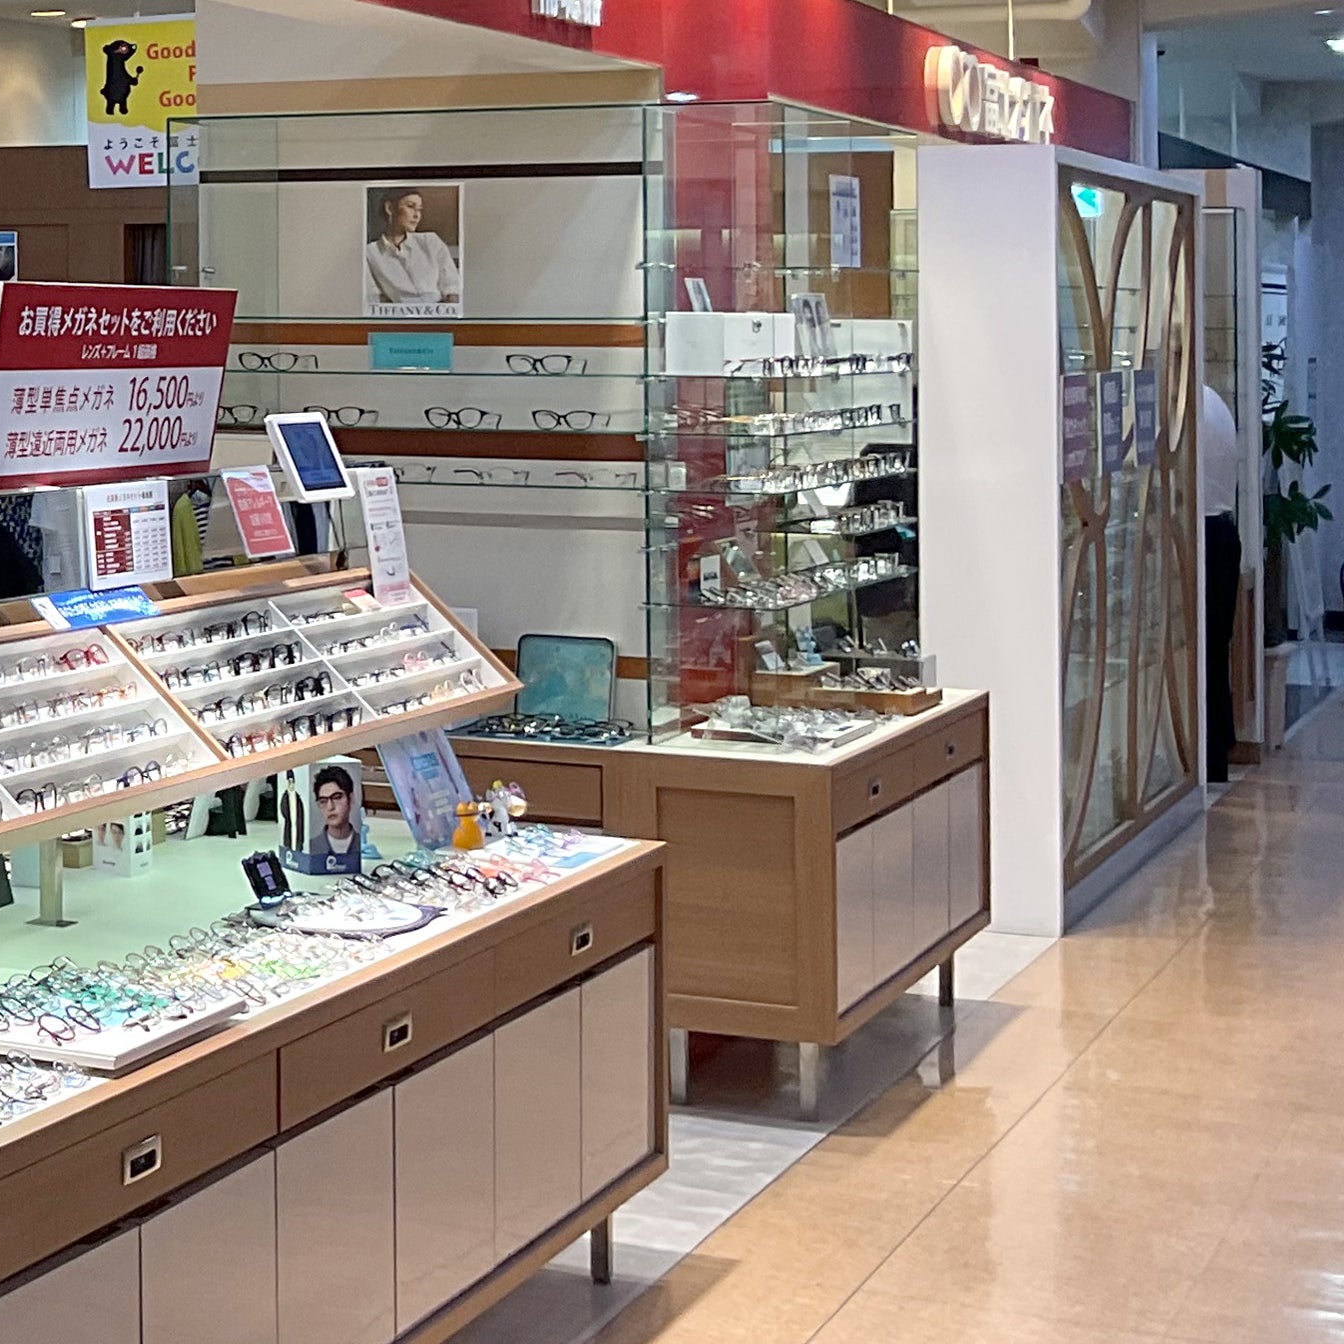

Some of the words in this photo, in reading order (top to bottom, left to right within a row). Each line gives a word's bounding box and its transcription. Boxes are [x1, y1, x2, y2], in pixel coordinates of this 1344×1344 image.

[18, 306, 217, 337] お買得メガネセットをご利用ください
[11, 384, 114, 415] 薄型単焦点メガネ
